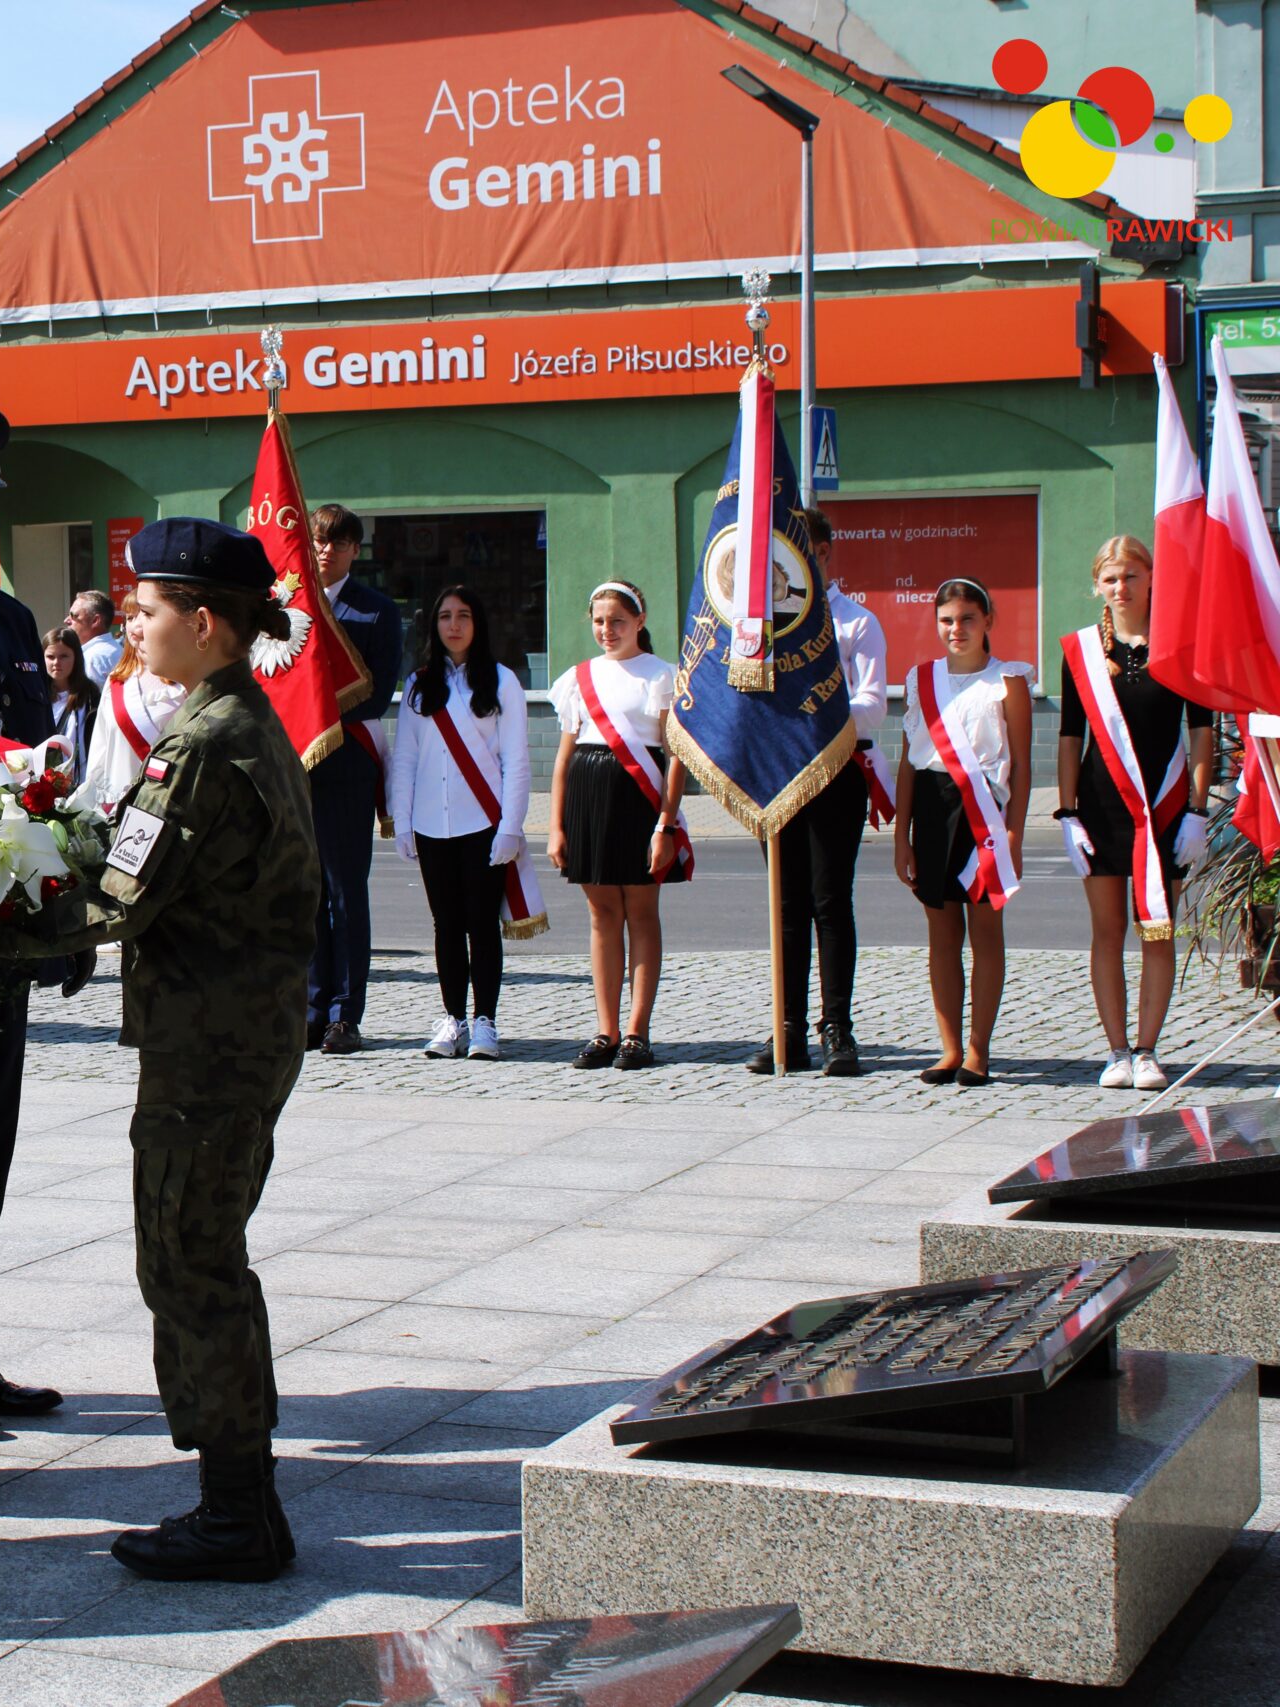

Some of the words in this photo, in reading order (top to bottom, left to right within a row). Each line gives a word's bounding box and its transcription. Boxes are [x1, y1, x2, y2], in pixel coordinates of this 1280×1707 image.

[424, 65, 626, 147] Apteka
[428, 138, 662, 211] Gemini
[1216, 319, 1252, 341] tel.
[303, 334, 486, 387] Gemini
[510, 346, 598, 383] Józefa
[245, 492, 300, 533] BÓG
[889, 529, 902, 538] w
[905, 524, 978, 542] godzinach:
[896, 574, 917, 587] nd.
